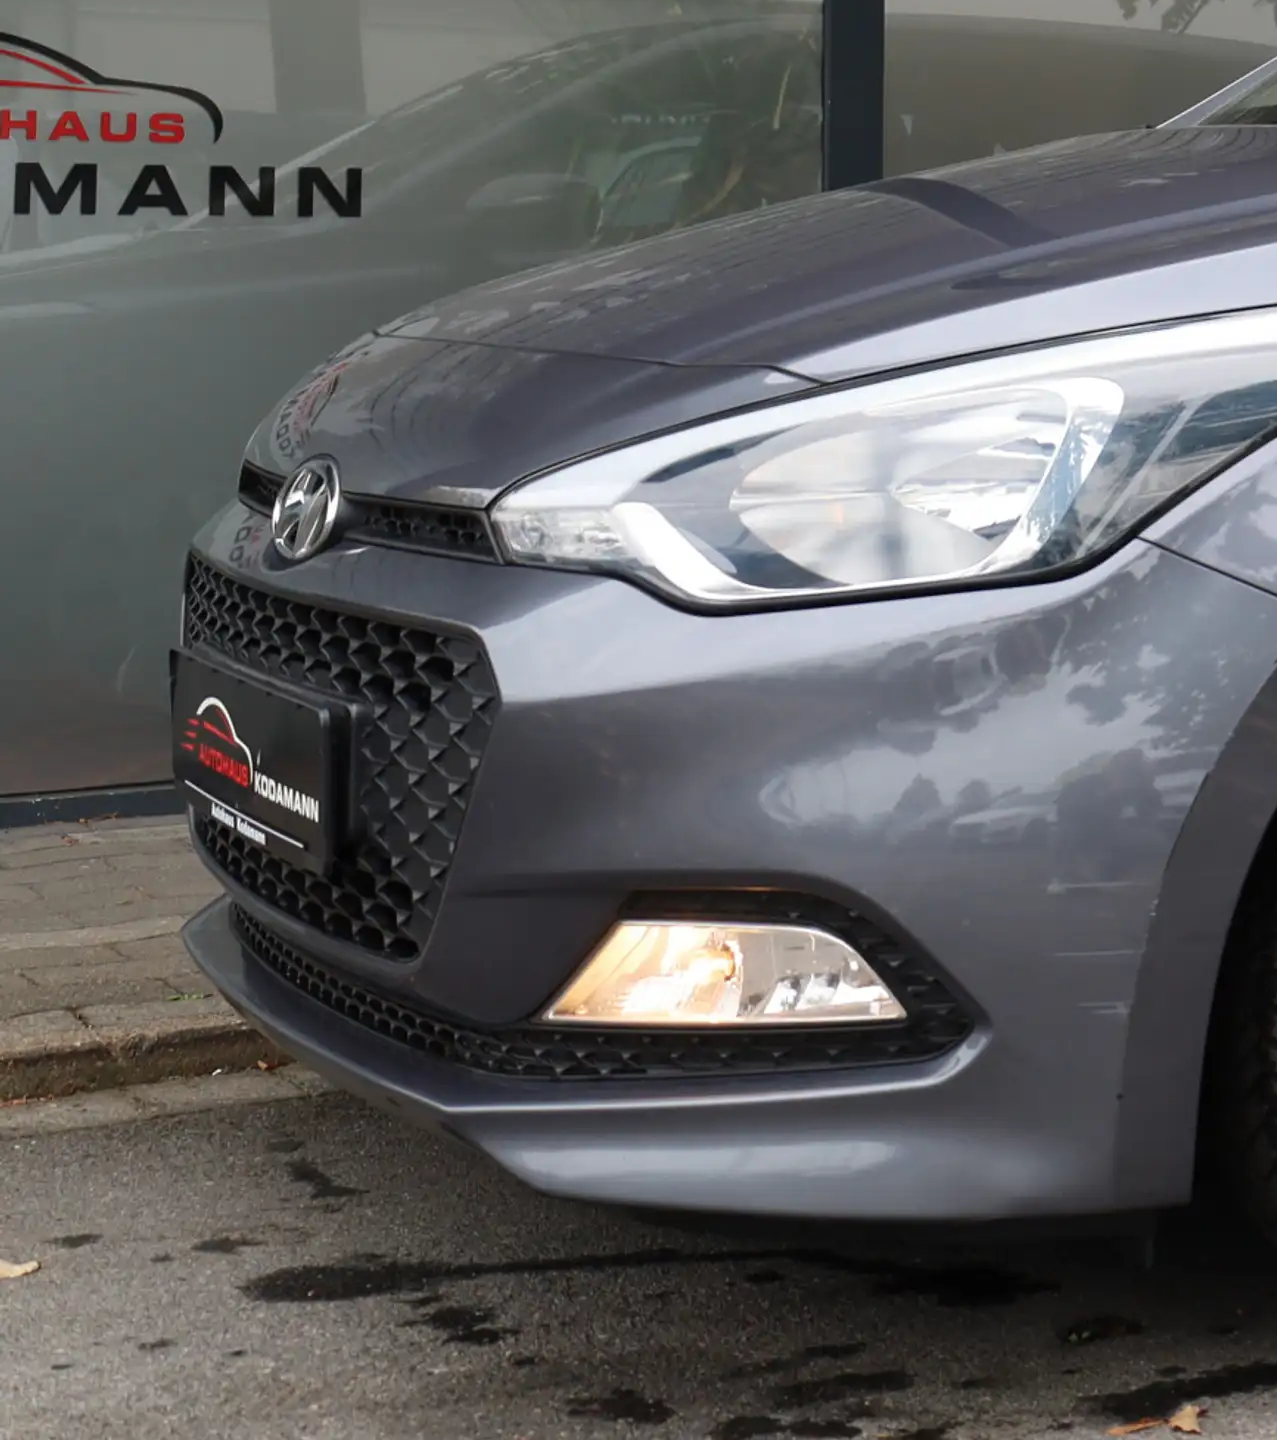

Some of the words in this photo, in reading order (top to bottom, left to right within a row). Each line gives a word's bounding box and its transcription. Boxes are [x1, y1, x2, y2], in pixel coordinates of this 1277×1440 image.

[0, 109, 186, 144] HAUS
[13, 162, 364, 218] MANN
[198, 743, 250, 789] AUTOHAUS
[254, 770, 320, 824] KODAMANN
